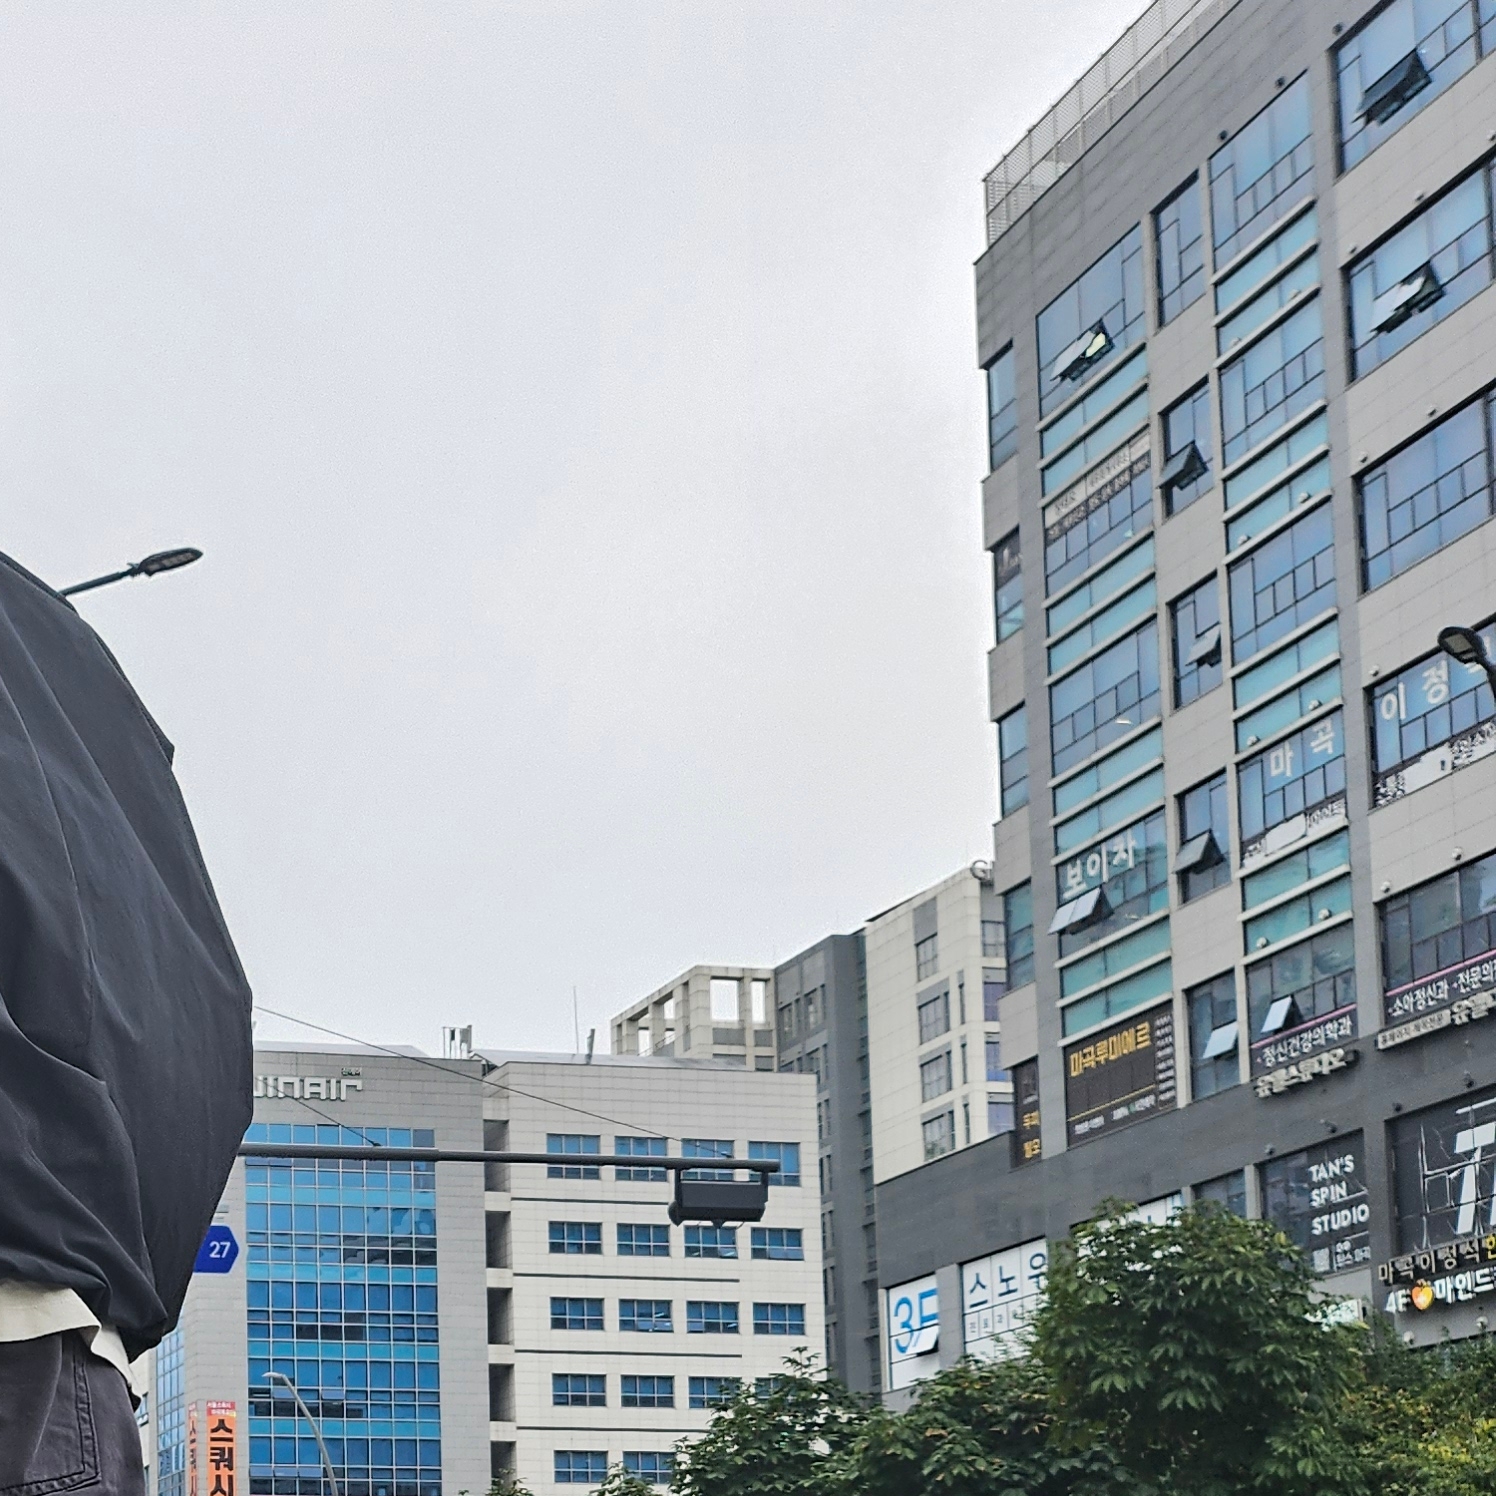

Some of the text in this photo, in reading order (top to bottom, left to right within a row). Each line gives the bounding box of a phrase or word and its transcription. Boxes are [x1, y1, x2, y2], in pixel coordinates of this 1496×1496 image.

[1270, 718, 1335, 777] 마곡
[1063, 829, 1138, 899] 보이자
[1263, 1014, 1353, 1068] 정신건강의학과
[1309, 1154, 1355, 1183] TAN'S
[1310, 1181, 1347, 1208] SPIN
[1311, 1203, 1370, 1236] STUDIO
[209, 1241, 231, 1258] 27
[1435, 1266, 1496, 1304] 마인드
